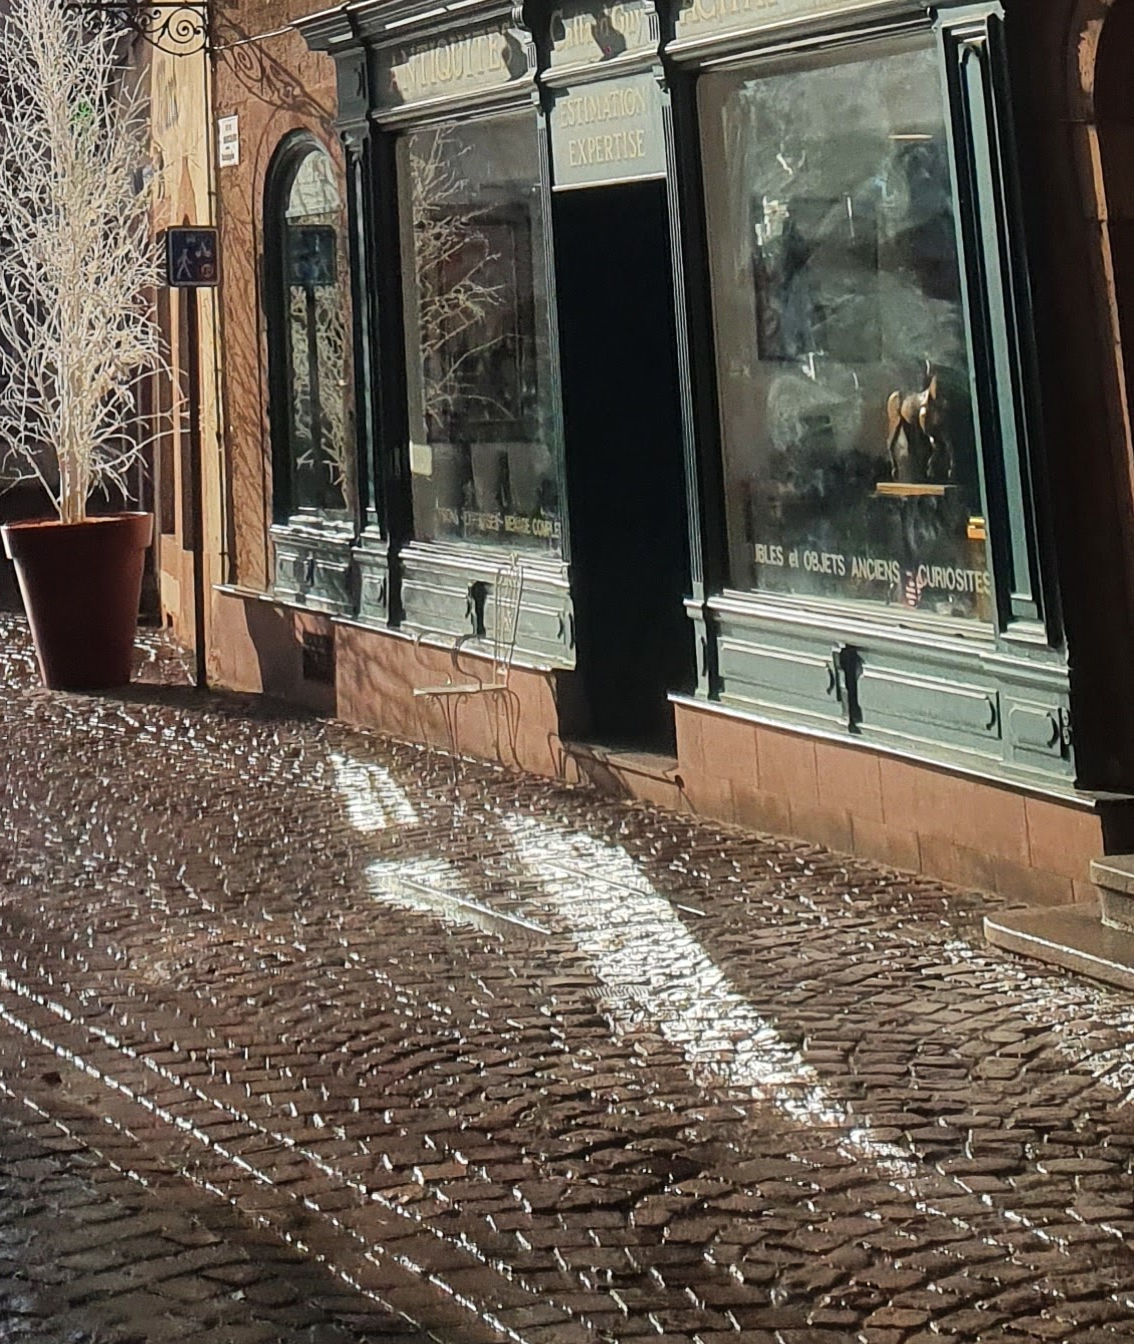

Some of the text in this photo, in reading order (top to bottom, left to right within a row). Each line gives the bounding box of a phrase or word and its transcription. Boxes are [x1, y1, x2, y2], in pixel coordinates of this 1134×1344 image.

[559, 87, 647, 128] ESTIMATION
[569, 130, 645, 167] EXPERTISE
[532, 518, 562, 538] COMPLE
[803, 550, 846, 577] OBJETS
[851, 556, 900, 584] ANCIENS
[916, 564, 991, 595] CURIOSITES
